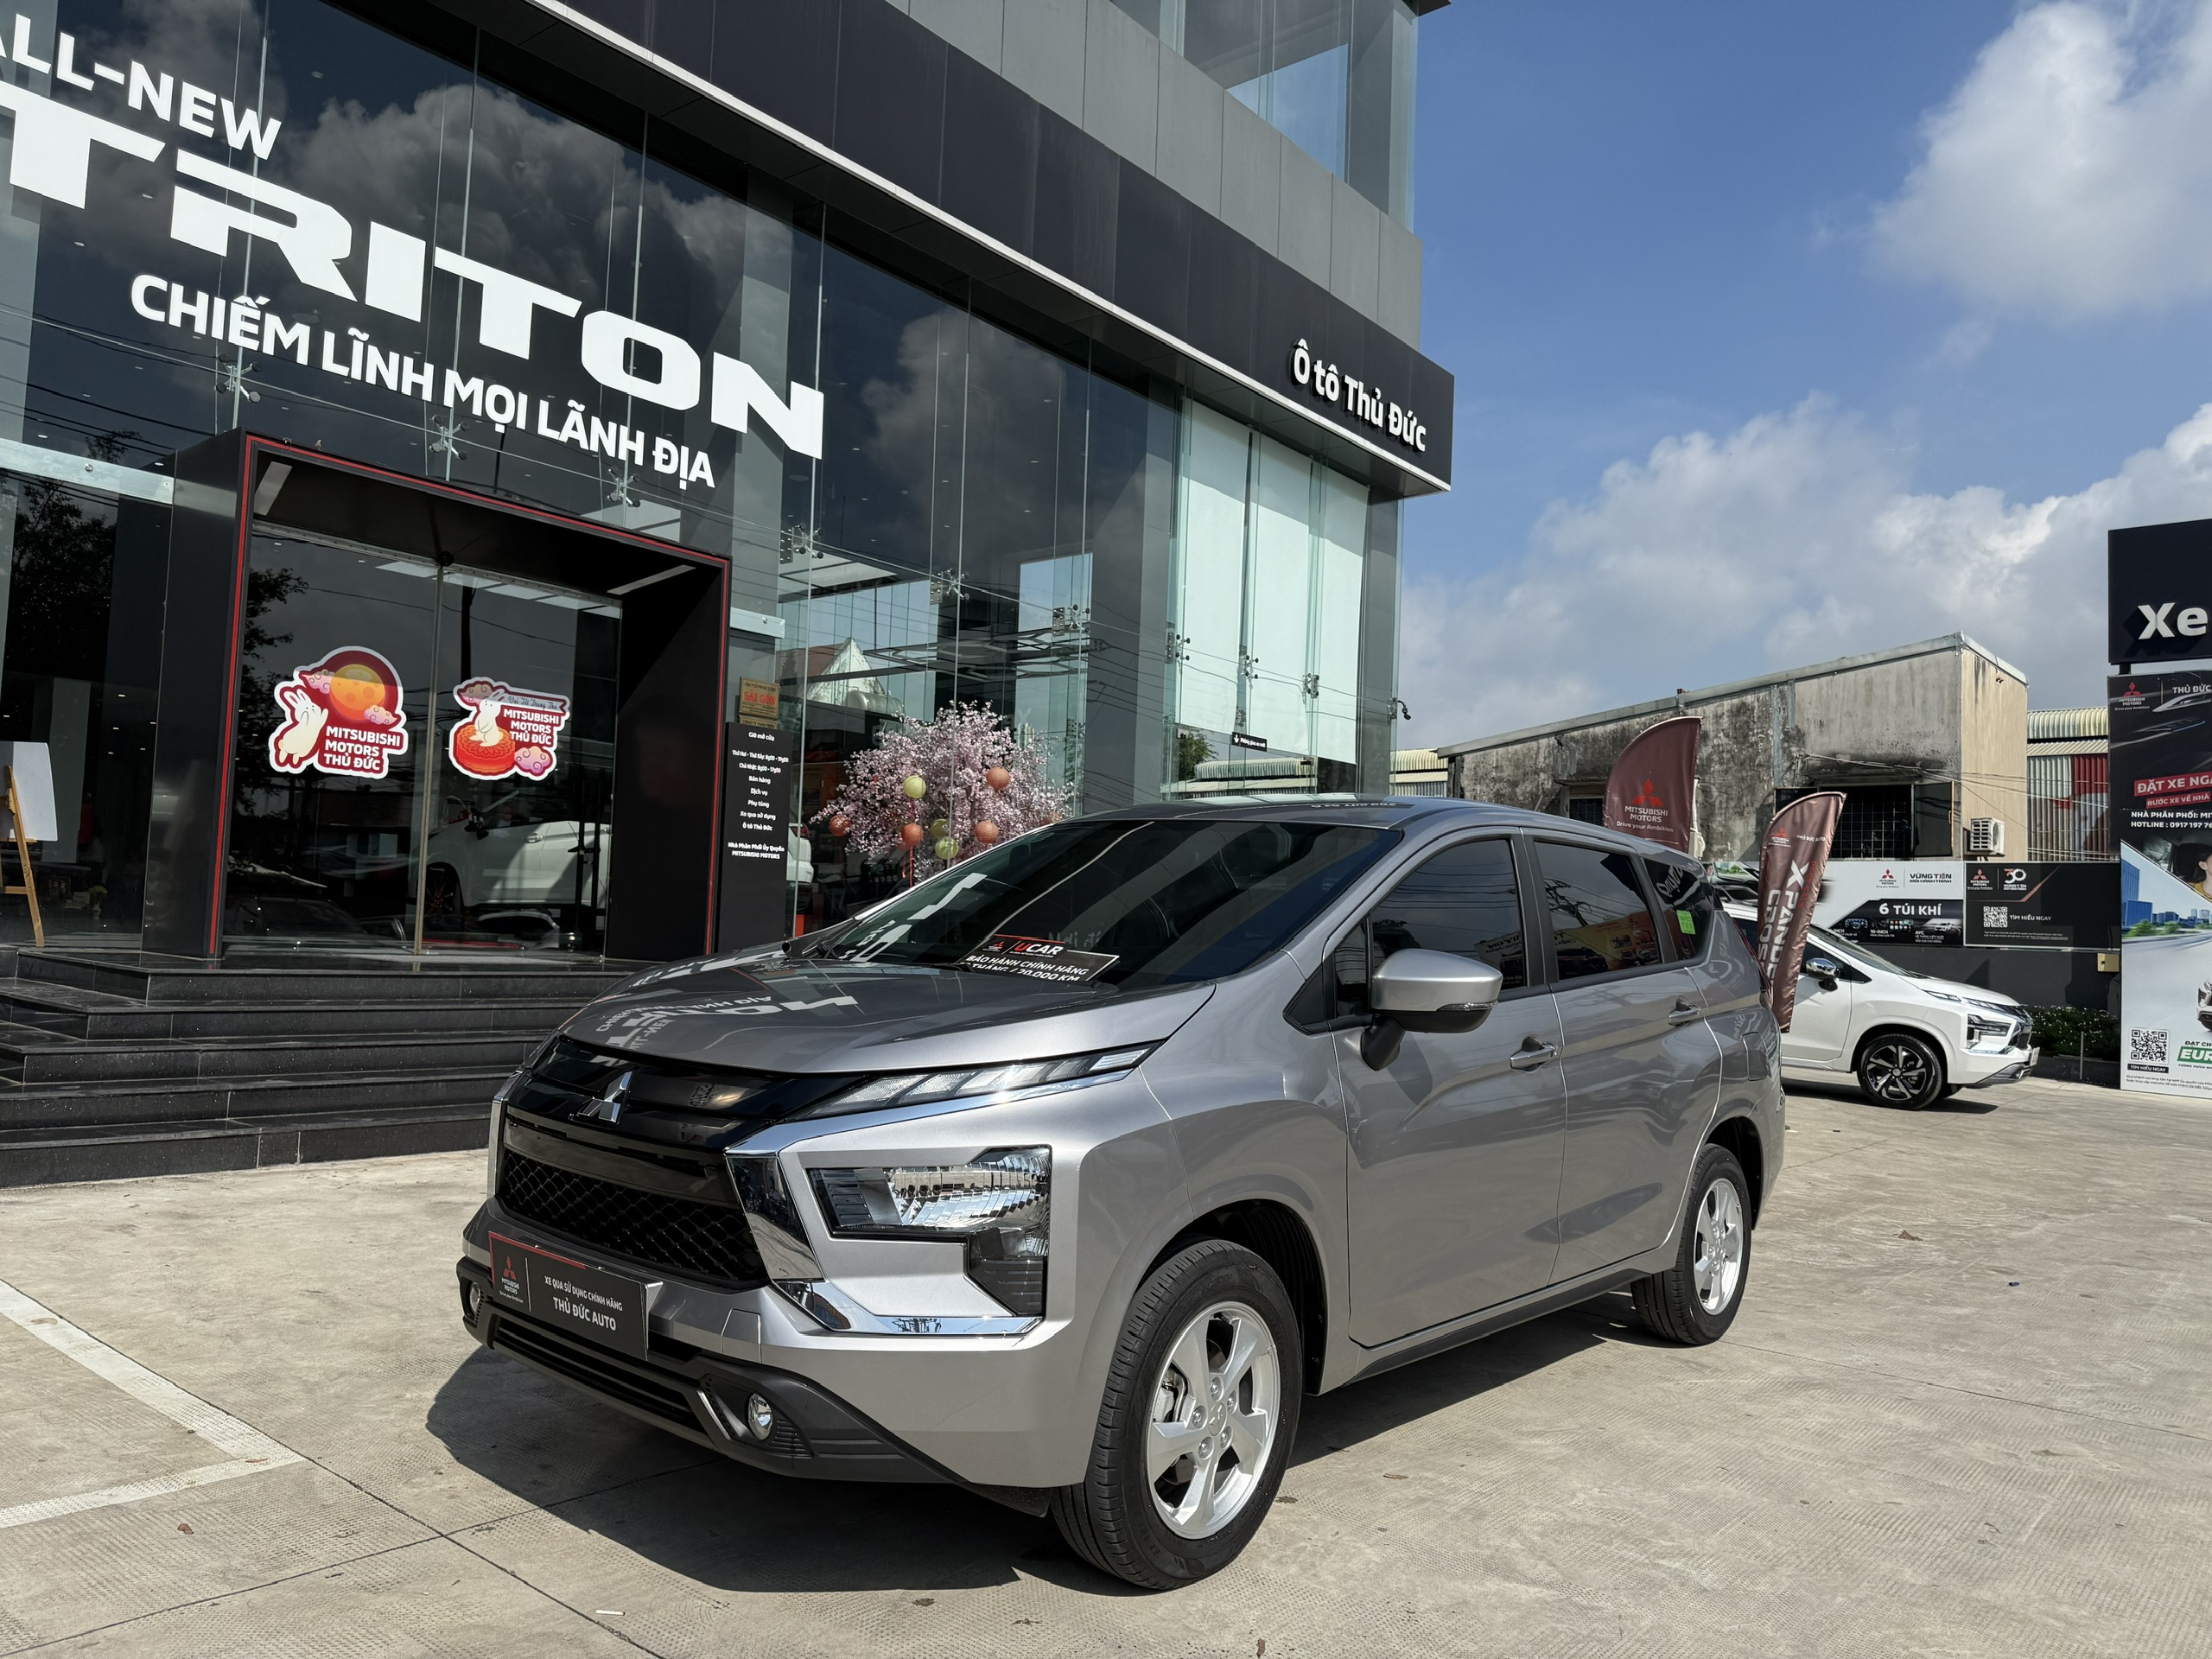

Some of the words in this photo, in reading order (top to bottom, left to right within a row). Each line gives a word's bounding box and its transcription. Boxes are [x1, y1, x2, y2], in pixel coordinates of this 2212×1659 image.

[0, 14, 282, 159] LL-NEW
[0, 80, 823, 459] TRITON
[131, 274, 311, 365] CHIẾM
[322, 327, 435, 404] LĨNH
[444, 368, 528, 434] MỌI
[537, 399, 645, 467] LÃNH
[653, 435, 715, 490] ĐỊA
[1294, 338, 1311, 385] Ô
[1313, 359, 1339, 402] tô
[1344, 374, 1384, 428] Thủ
[1388, 401, 1427, 452] Đức
[2138, 602, 2209, 640] Xe
[2172, 684, 2190, 694] THỦ
[2192, 683, 2212, 693] ĐỨC
[504, 709, 559, 725] MITSUBISHI
[511, 720, 551, 734] MOTORS
[326, 726, 400, 747] MITSUBISHI
[510, 729, 530, 742] THỦ
[531, 733, 551, 745] ĐỨC
[325, 739, 379, 757] MOTORS
[324, 752, 351, 767] THỦ
[353, 756, 380, 771] ĐỨC
[2137, 779, 2164, 794] ĐẶT
[2167, 778, 2185, 789] XE
[2192, 792, 2209, 801] NHÀ
[1624, 805, 1668, 817] MITSUBISHI
[1630, 813, 1662, 823] MOTORS
[2151, 810, 2174, 818] PHÂN
[2176, 810, 2198, 818] PHỐI:
[1646, 824, 1674, 833] Ambition
[1879, 902, 1889, 915] 6
[1893, 903, 1915, 915] TÚI
[1918, 903, 1942, 915] KHÍ
[1758, 889, 1781, 969] CROS
[1767, 860, 1809, 993] XPANDE
[1014, 943, 1064, 955] UCAR
[988, 957, 1021, 966] HÀNH
[1020, 962, 1055, 970] CHÍNH
[1055, 965, 1089, 975] HÃNG
[544, 1275, 552, 1285] XE
[552, 1279, 564, 1290] QUA
[564, 1281, 572, 1294] SỬ
[572, 1287, 588, 1299] DỤNG
[588, 1291, 606, 1306] CHÍNH
[553, 1297, 570, 1315] THỦ
[572, 1303, 591, 1322] ĐỨC
[592, 1313, 616, 1331] AUTO
